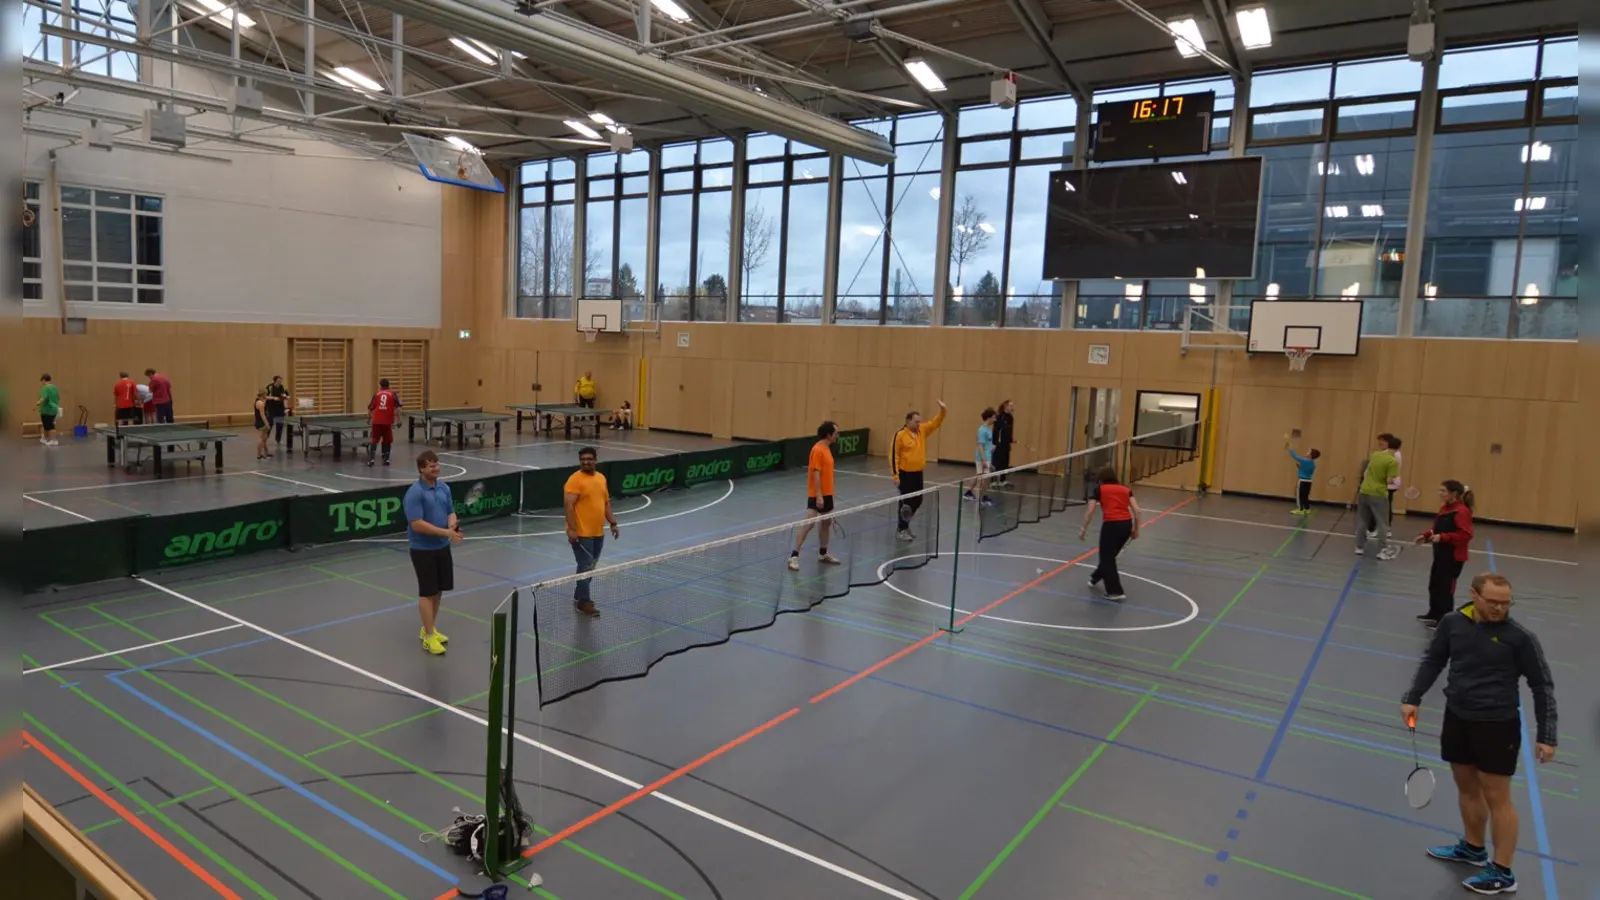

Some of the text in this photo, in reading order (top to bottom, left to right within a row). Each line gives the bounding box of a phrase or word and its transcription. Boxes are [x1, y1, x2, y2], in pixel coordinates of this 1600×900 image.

[1133, 96, 1184, 119] 16:17
[380, 394, 387, 406] 9
[838, 435, 860, 453] TSP
[687, 459, 731, 478] andro
[746, 451, 782, 469] andro
[622, 468, 675, 488] andro
[329, 496, 401, 533] TSP
[164, 520, 279, 558] andro
